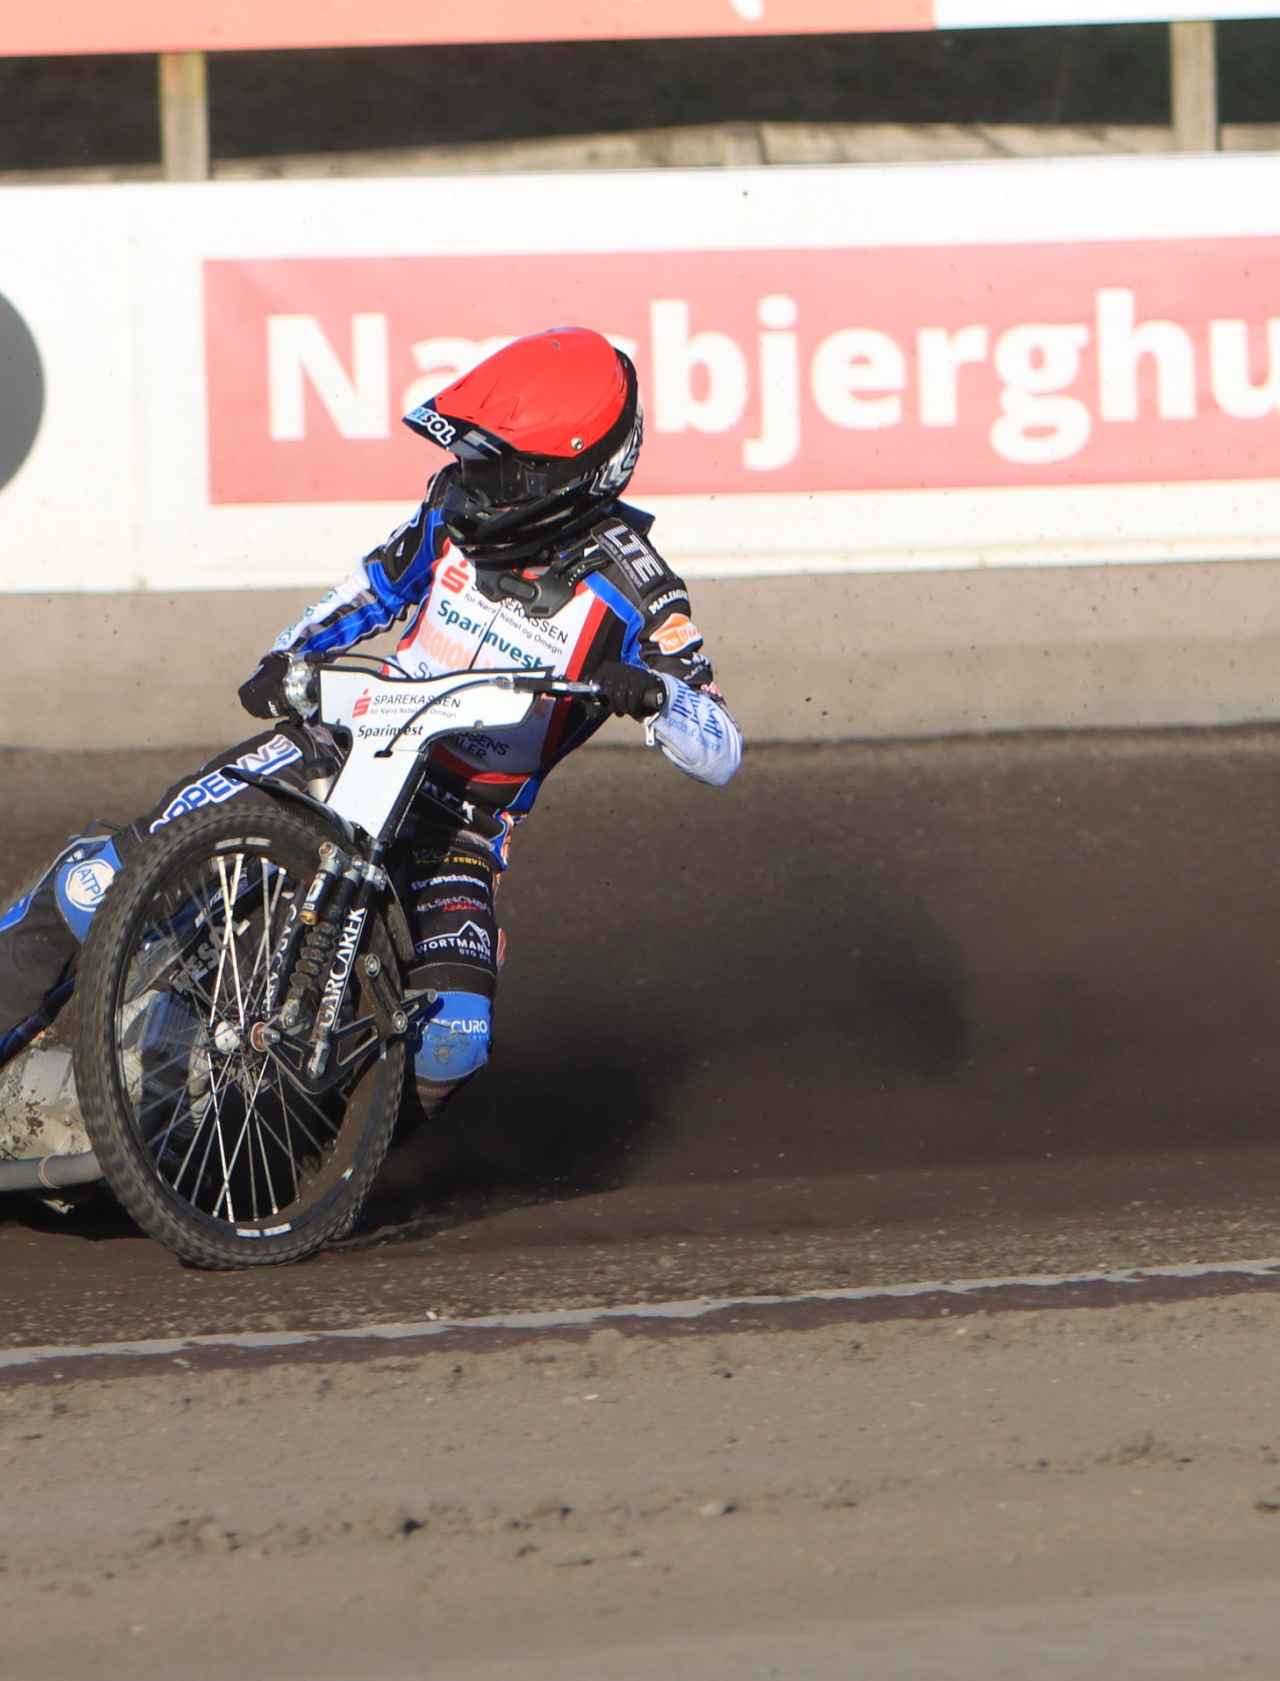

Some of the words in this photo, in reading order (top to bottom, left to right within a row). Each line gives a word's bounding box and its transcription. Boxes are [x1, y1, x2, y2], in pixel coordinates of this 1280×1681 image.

[266, 287, 1280, 471] Nbjerghu
[437, 599, 544, 669] Sparinvest
[357, 723, 424, 740] Sparinest
